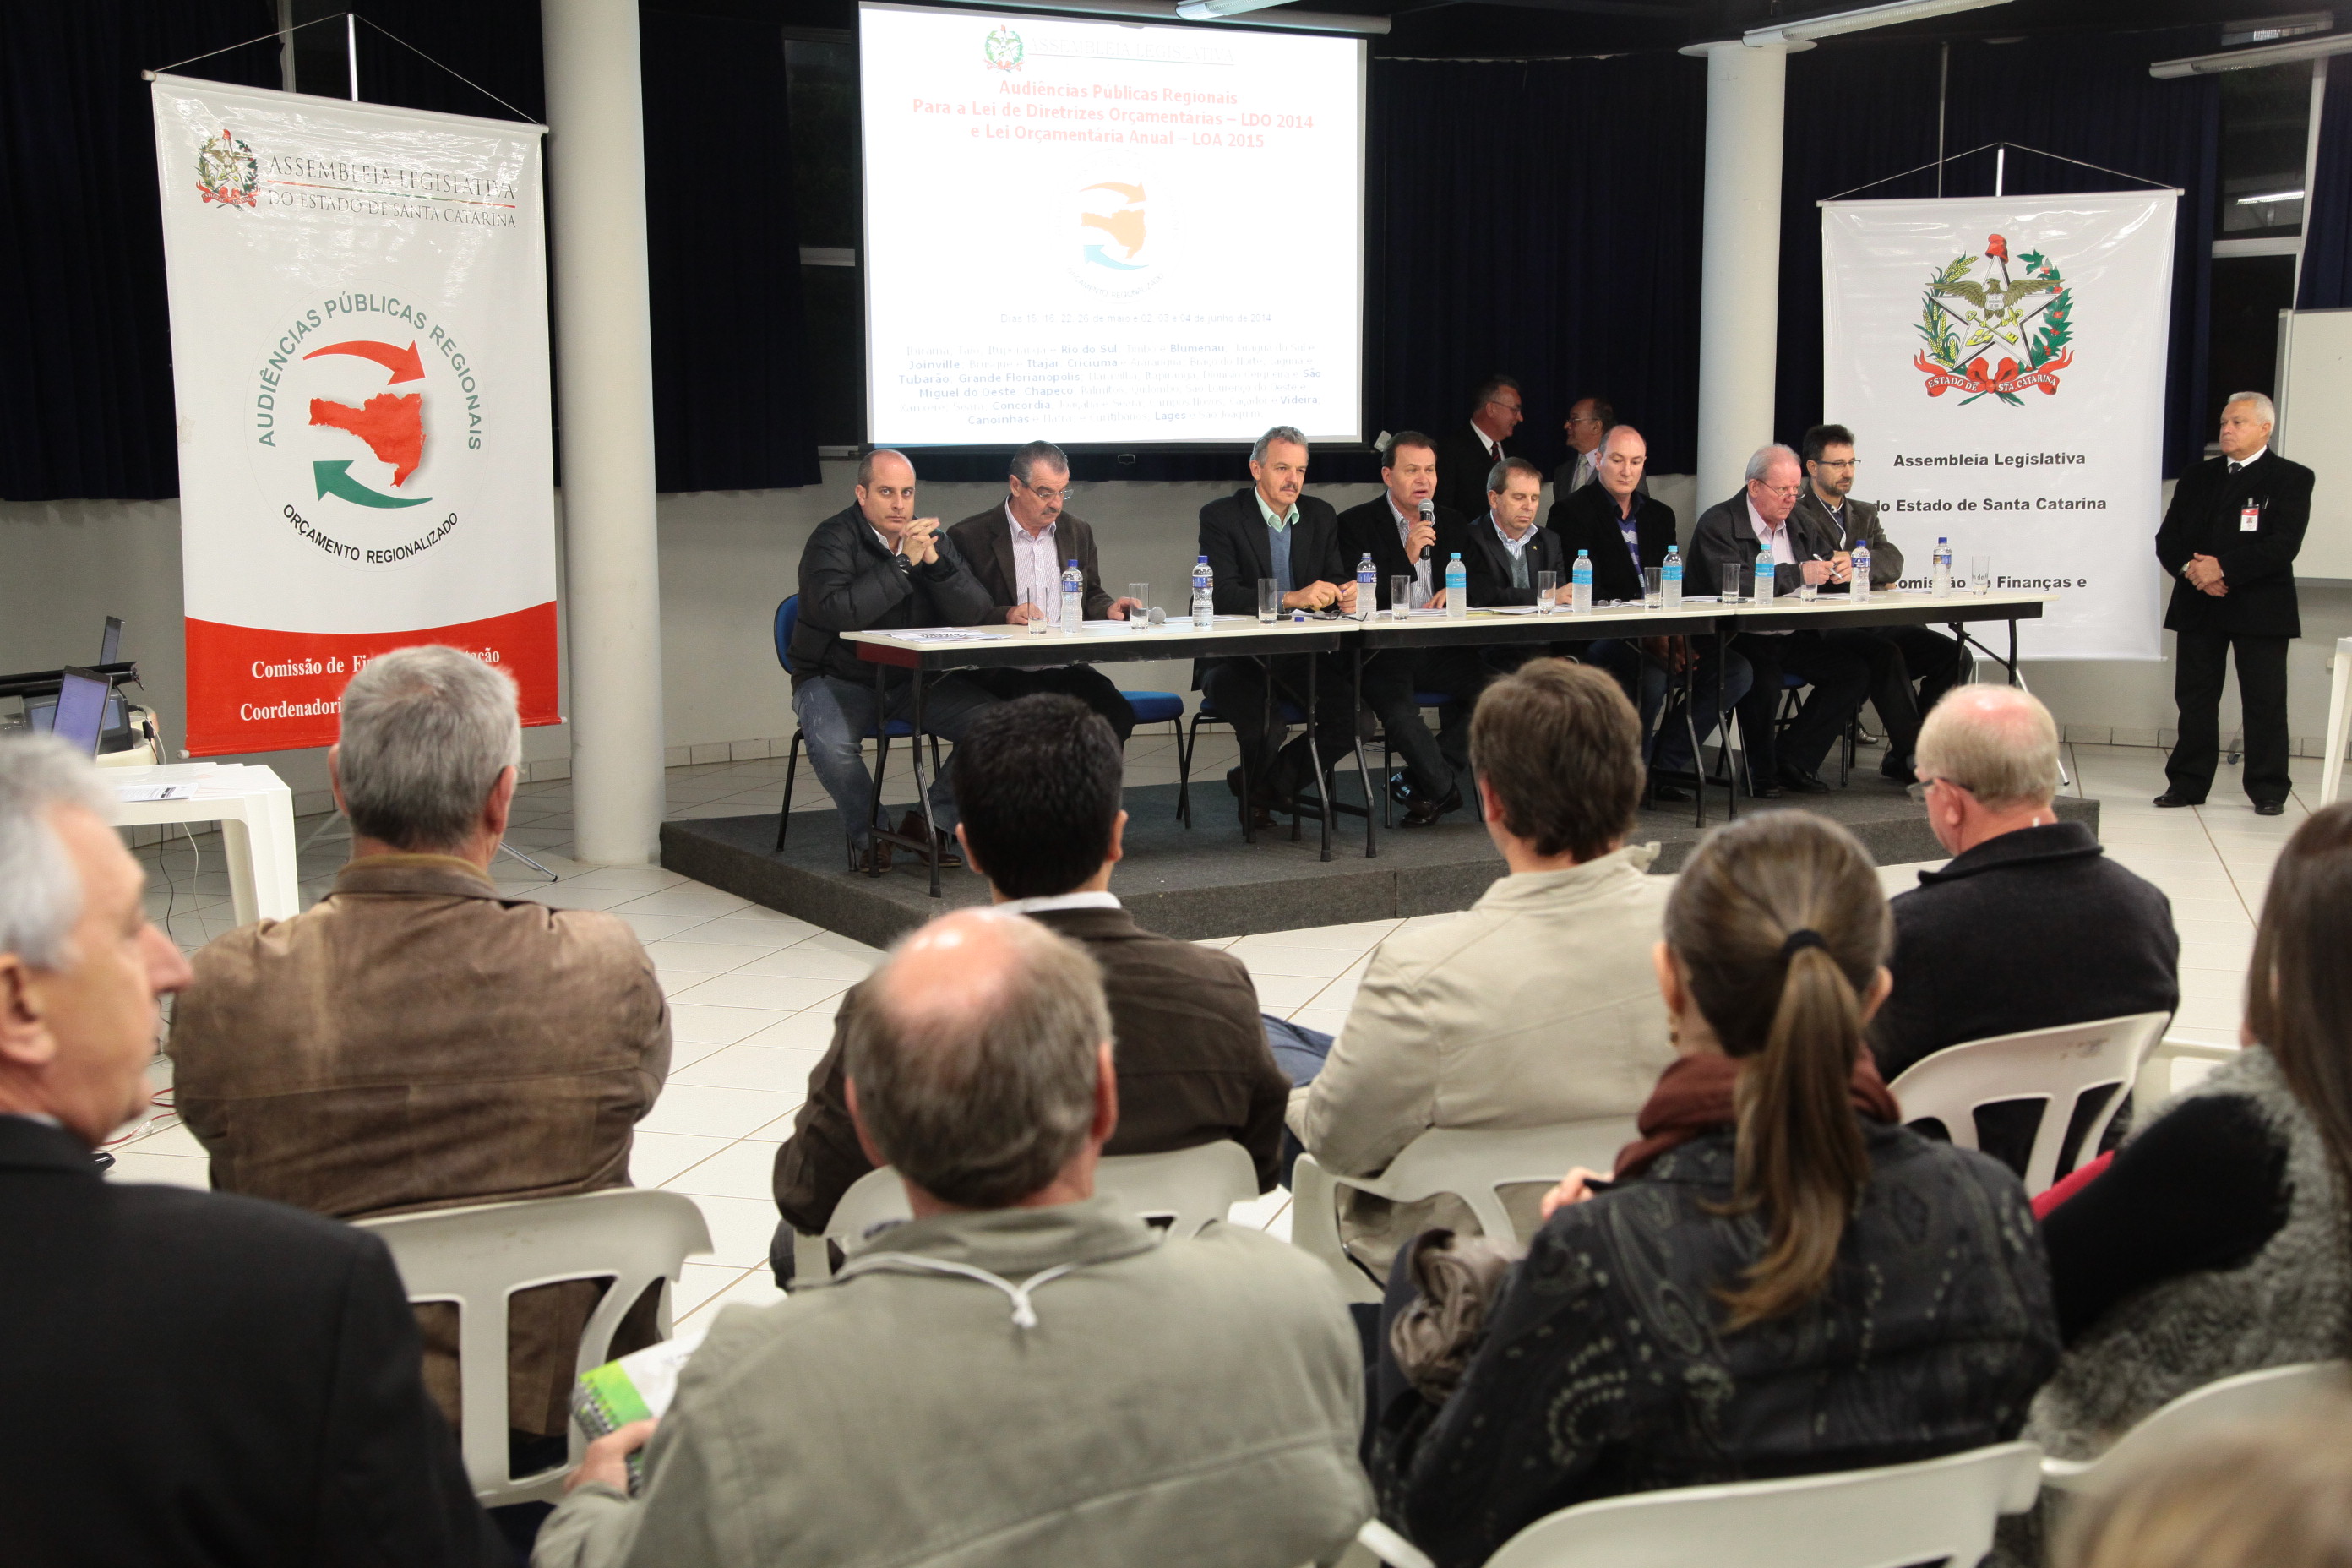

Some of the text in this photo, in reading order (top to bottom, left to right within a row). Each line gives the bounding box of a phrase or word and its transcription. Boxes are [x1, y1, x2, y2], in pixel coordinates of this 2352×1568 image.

[1030, 36, 1235, 63] ASSEMBLEIA LEGISLATIVA
[999, 79, 1238, 106] Audiências Públicas Regionais
[912, 98, 951, 114] Para
[956, 103, 966, 115] a
[972, 101, 996, 117] Lei
[1002, 101, 1021, 117] de
[1026, 103, 1105, 120] Diretrizes
[1108, 107, 1222, 125] Orçamentárias
[1241, 112, 1271, 127] LDO
[1277, 114, 1314, 128] 2014
[970, 127, 980, 138] e
[986, 123, 1009, 139] Lei
[1015, 125, 1124, 143] Orçamentária
[1130, 129, 1173, 145] Anual
[1192, 132, 1222, 146] LOA
[1228, 133, 1265, 148] 2015
[269, 155, 515, 199] ASSEMBLEIA LEGISLATIVA
[269, 189, 294, 207] DO
[301, 193, 362, 213] ESTADO
[368, 200, 388, 216] DE
[393, 203, 439, 221] SANTA
[444, 208, 516, 228] CATARINA
[1000, 313, 1022, 323] Dias
[1092, 313, 1104, 323] de
[1108, 313, 1130, 323] maio
[1194, 313, 1205, 323] de
[1207, 313, 1233, 325] junho
[1237, 313, 1248, 323] de
[1250, 313, 1271, 323] 2014
[1061, 344, 1078, 354] Rio
[1082, 344, 1096, 354] do
[257, 291, 482, 450] AUDIÊNCIAS PÚBLICAS REGIONAIS
[959, 373, 1002, 383] Grande
[1303, 368, 1321, 378] São
[1928, 377, 1964, 388] ESTADO
[1967, 382, 1979, 392] DE
[2017, 374, 2056, 389] CATARINA
[919, 387, 959, 400] Miguel
[964, 387, 978, 397] do
[968, 414, 1029, 425] Canoinhas
[1155, 411, 1186, 422] Lages
[1893, 452, 2086, 469] Assembleia Legislativa
[1896, 499, 1952, 513] Estado
[1957, 498, 1978, 512] de
[1982, 498, 2030, 512] Santa
[2035, 497, 2107, 511] Catarina
[283, 504, 458, 564] ORÇAMENTO REGIONALIZADO
[1997, 575, 2072, 591] Finanças
[2077, 578, 2087, 588] e
[252, 657, 323, 679] Comissão
[326, 656, 345, 674] de
